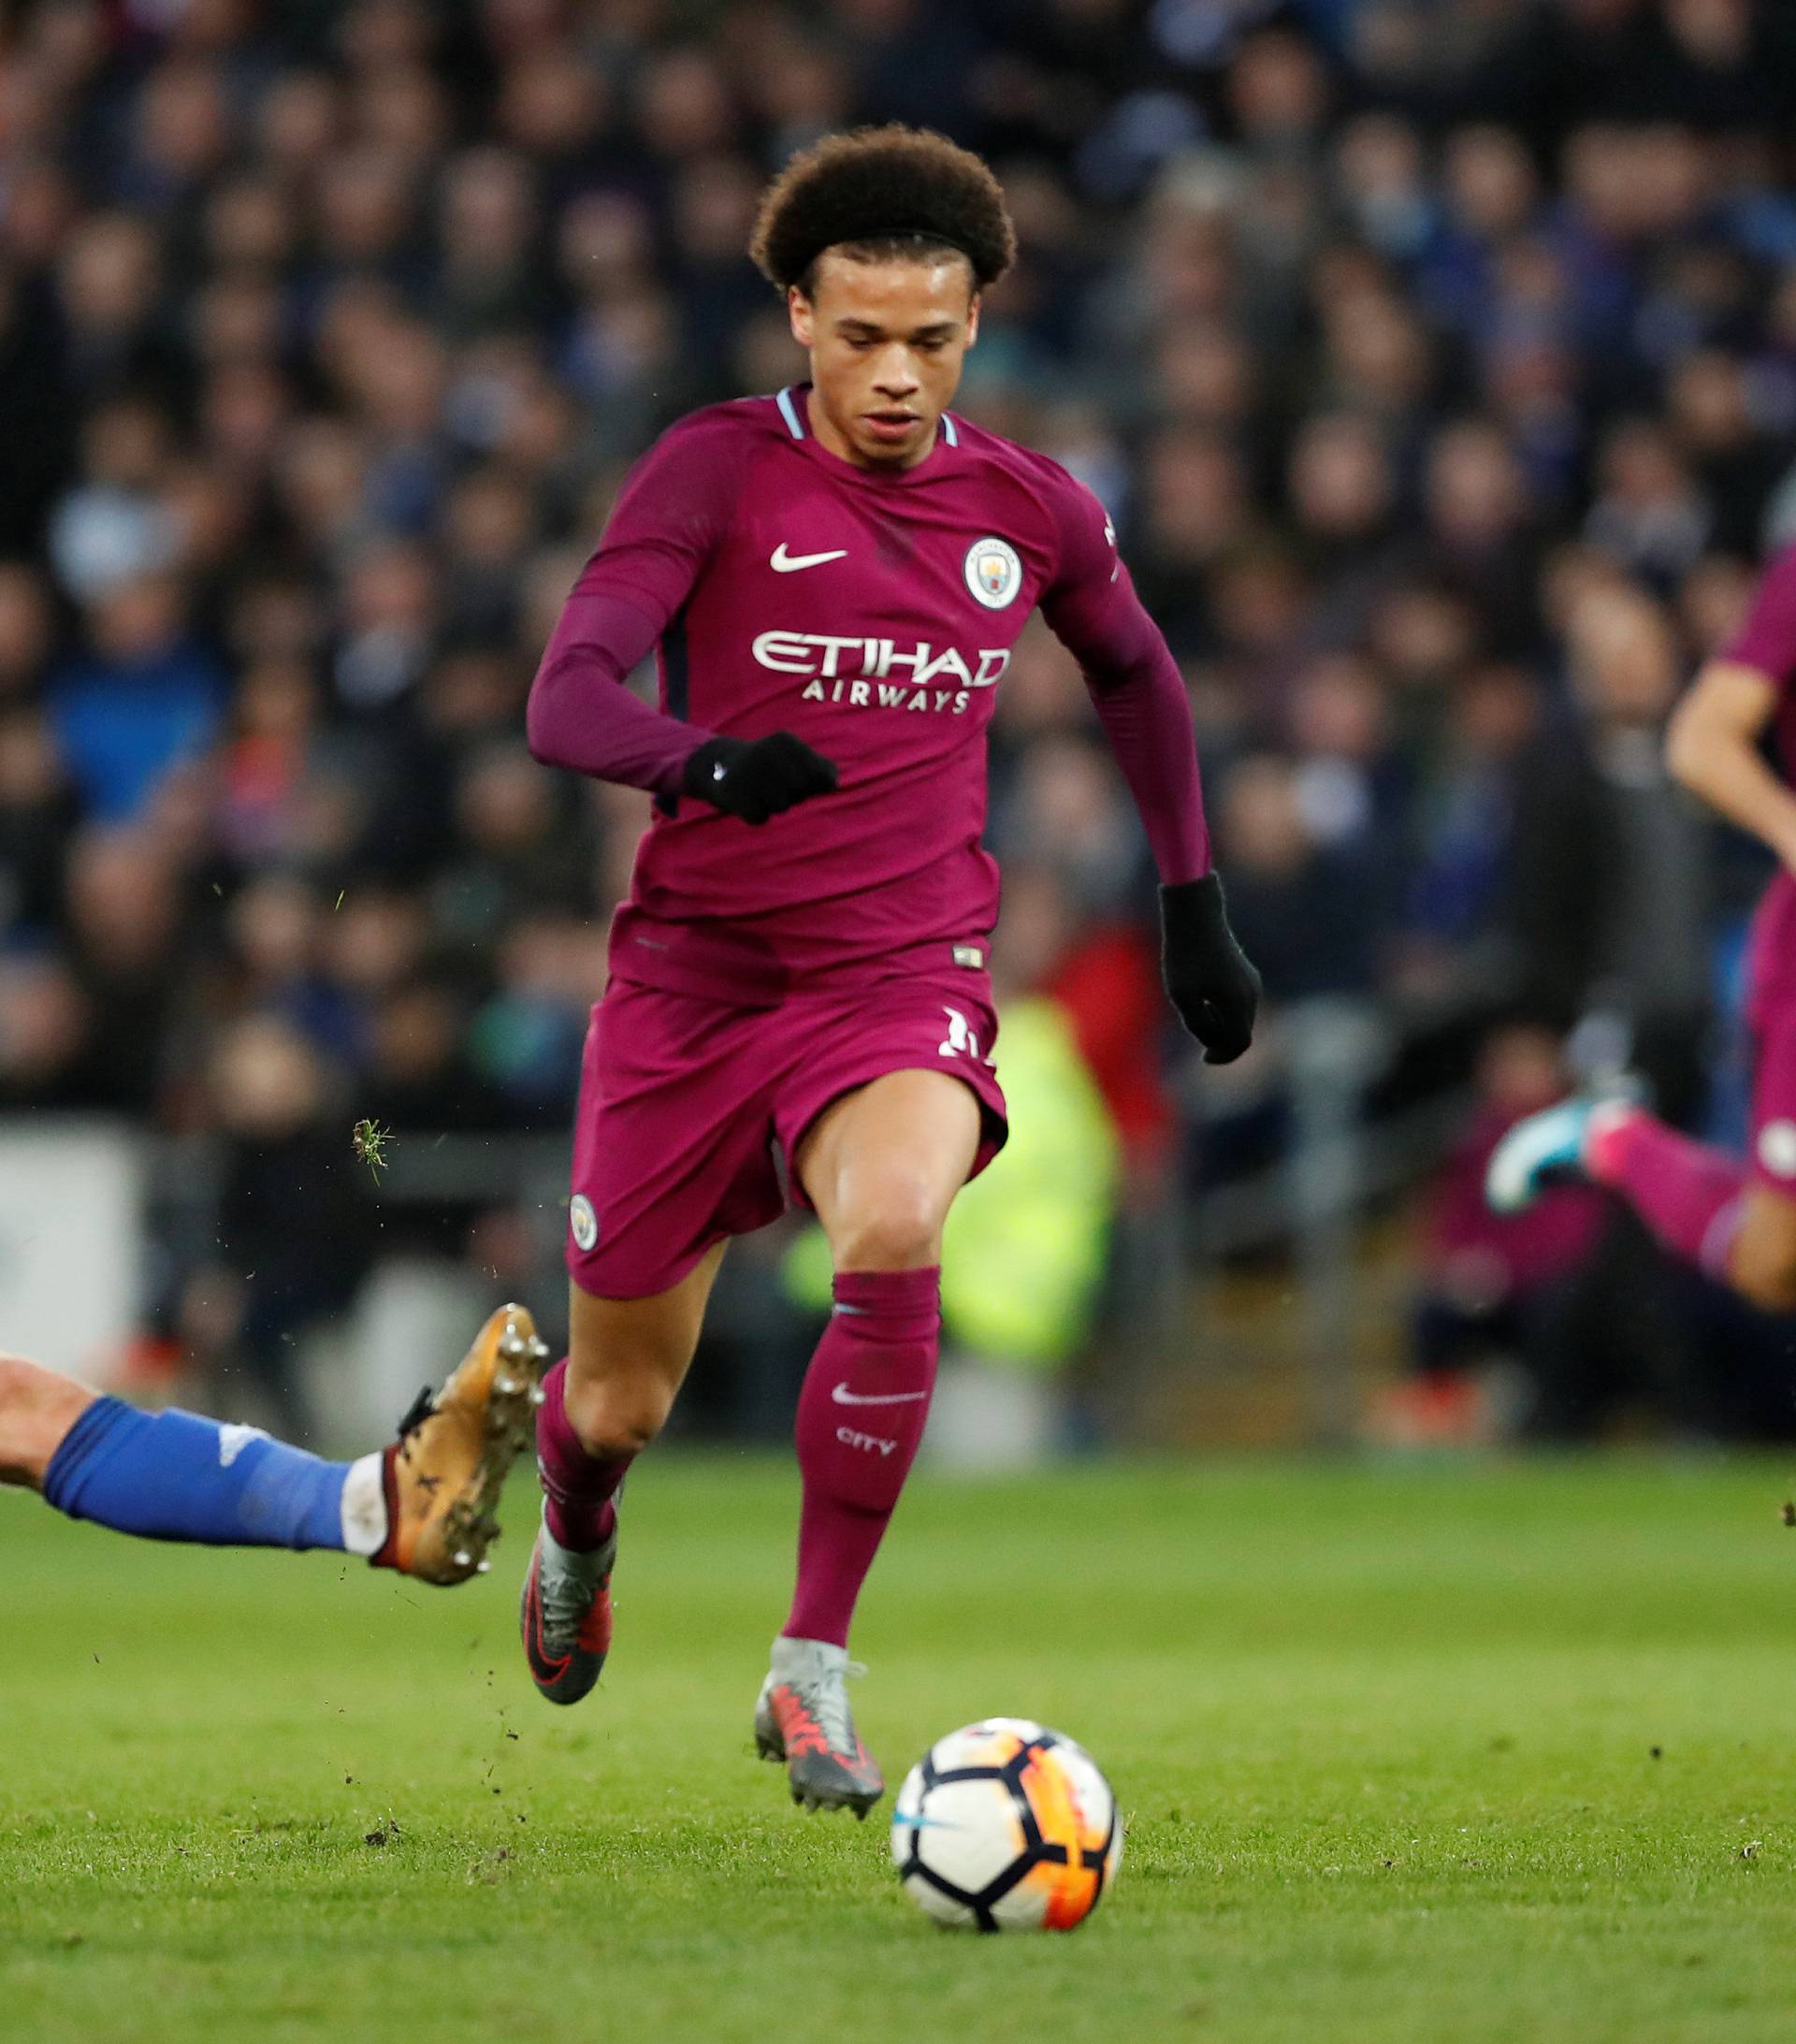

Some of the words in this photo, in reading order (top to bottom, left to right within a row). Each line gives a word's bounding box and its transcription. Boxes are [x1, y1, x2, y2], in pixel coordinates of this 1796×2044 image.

[752, 631, 1011, 687] ETIHAD
[802, 680, 970, 714] AIRWAYS
[836, 1427, 897, 1456] CITY
